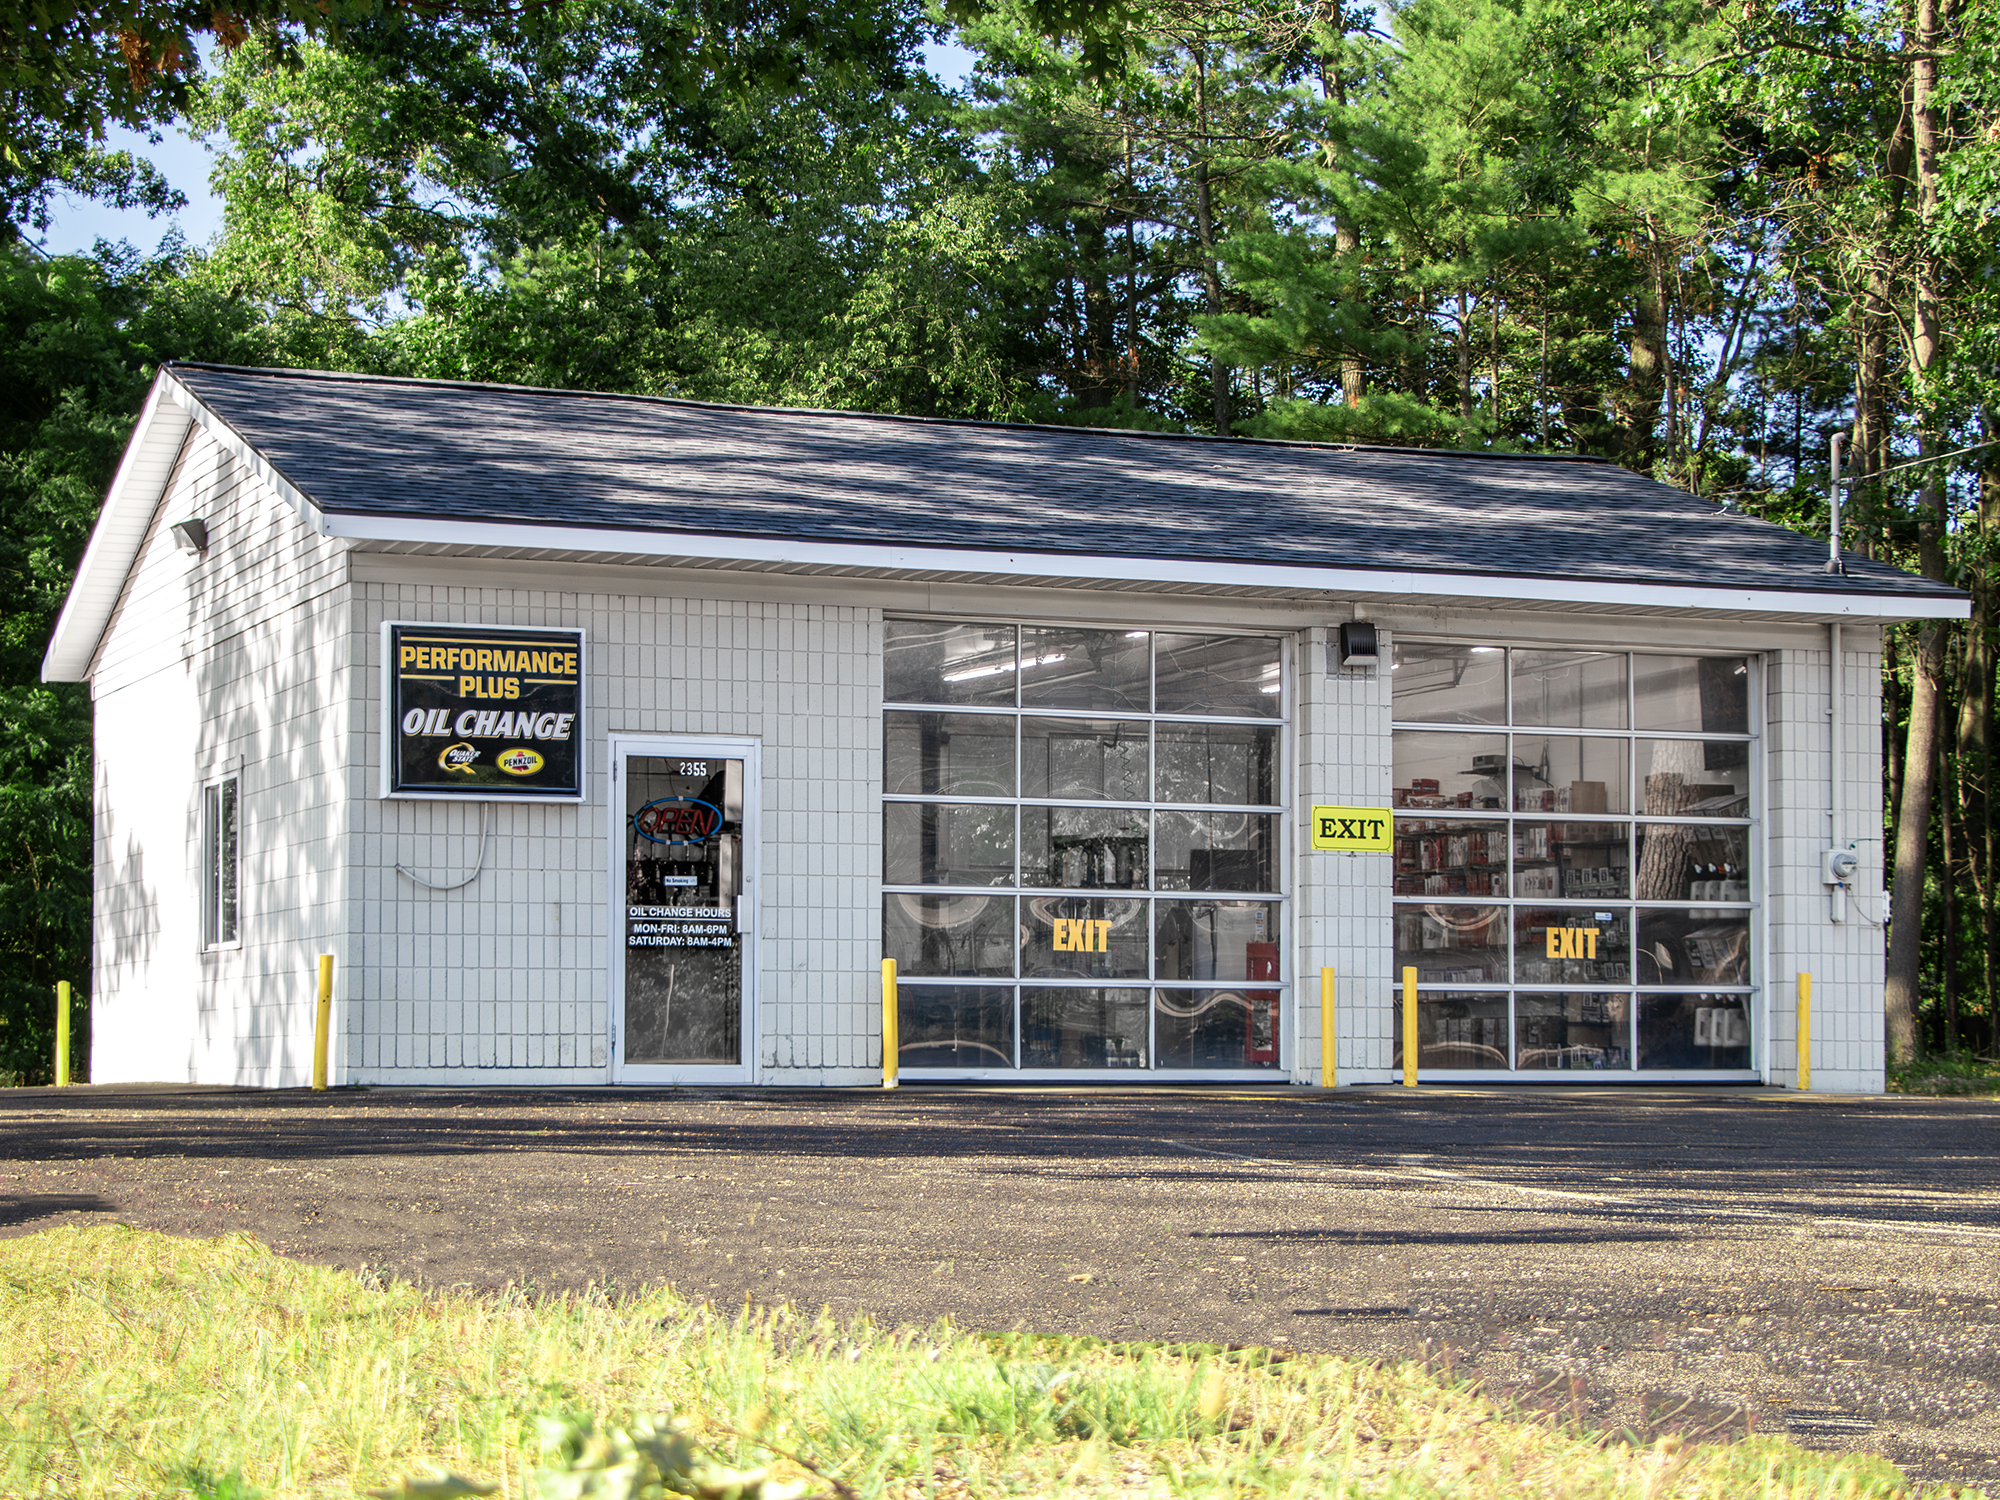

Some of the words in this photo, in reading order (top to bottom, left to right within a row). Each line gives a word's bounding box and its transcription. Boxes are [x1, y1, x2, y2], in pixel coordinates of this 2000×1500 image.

[400, 646, 577, 674] PERFORMANCE
[460, 675, 520, 699] PLUS
[403, 708, 452, 736] OIL
[455, 709, 575, 740] CHANGE
[449, 749, 481, 758] QUAKER
[452, 755, 475, 763] STATE
[503, 755, 538, 767] PENNZOIL
[680, 762, 707, 776] 2355
[640, 807, 715, 835] OPEN
[1319, 817, 1385, 841] EXIT
[629, 907, 647, 917] OIL
[649, 907, 693, 918] CHANGE
[695, 908, 731, 918] HOURS
[634, 924, 680, 934] MON-FRI:
[682, 924, 727, 935] 8AM-6PM
[1053, 918, 1112, 953] EXIT
[629, 936, 685, 946] SATURDAY:
[687, 936, 732, 947] 8AM-4PM
[1546, 927, 1600, 959] EXIT
